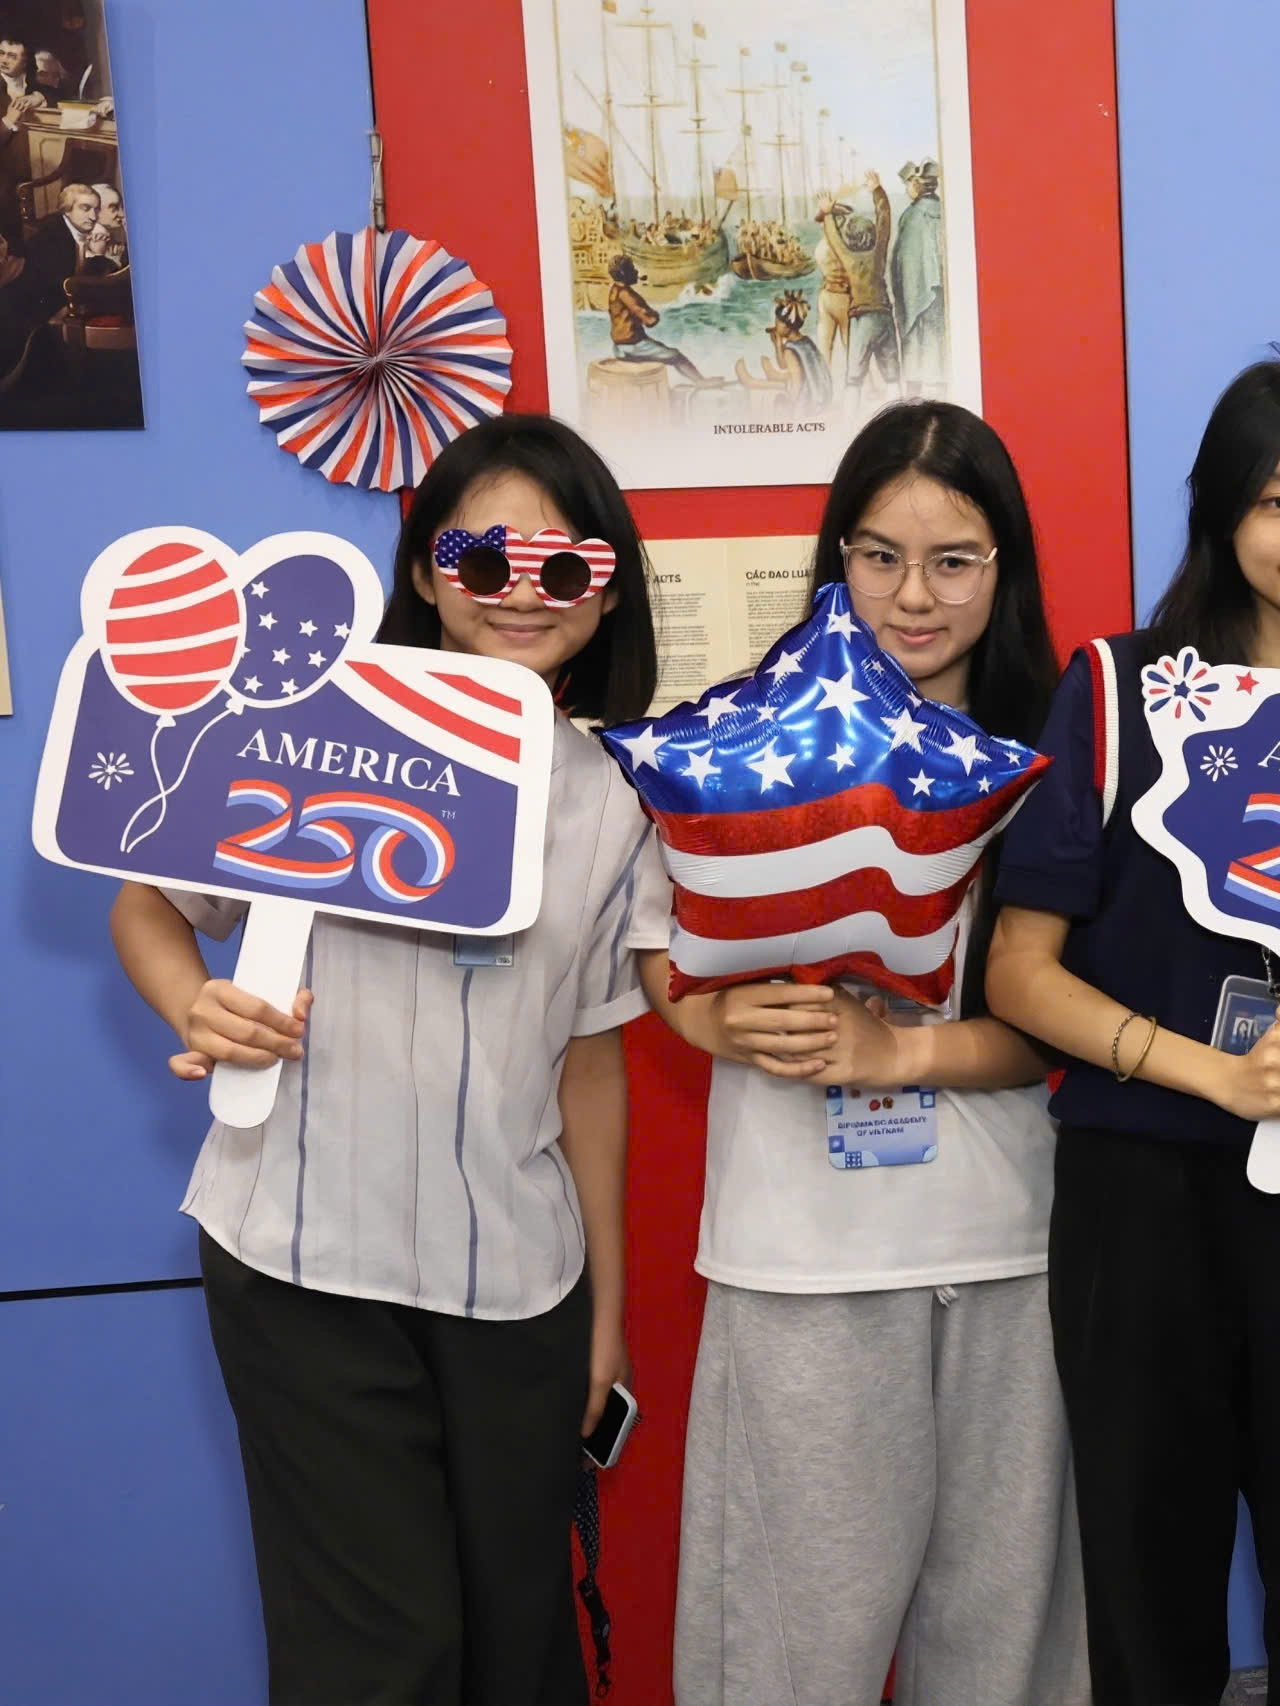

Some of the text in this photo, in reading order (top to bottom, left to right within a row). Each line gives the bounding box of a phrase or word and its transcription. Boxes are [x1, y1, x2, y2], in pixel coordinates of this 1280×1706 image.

[714, 422, 825, 434] INTOLERABLE ACTS
[653, 574, 682, 583] ACTS
[236, 728, 461, 796] AMERICA
[441, 809, 456, 820] TM
[213, 779, 455, 903] 250
